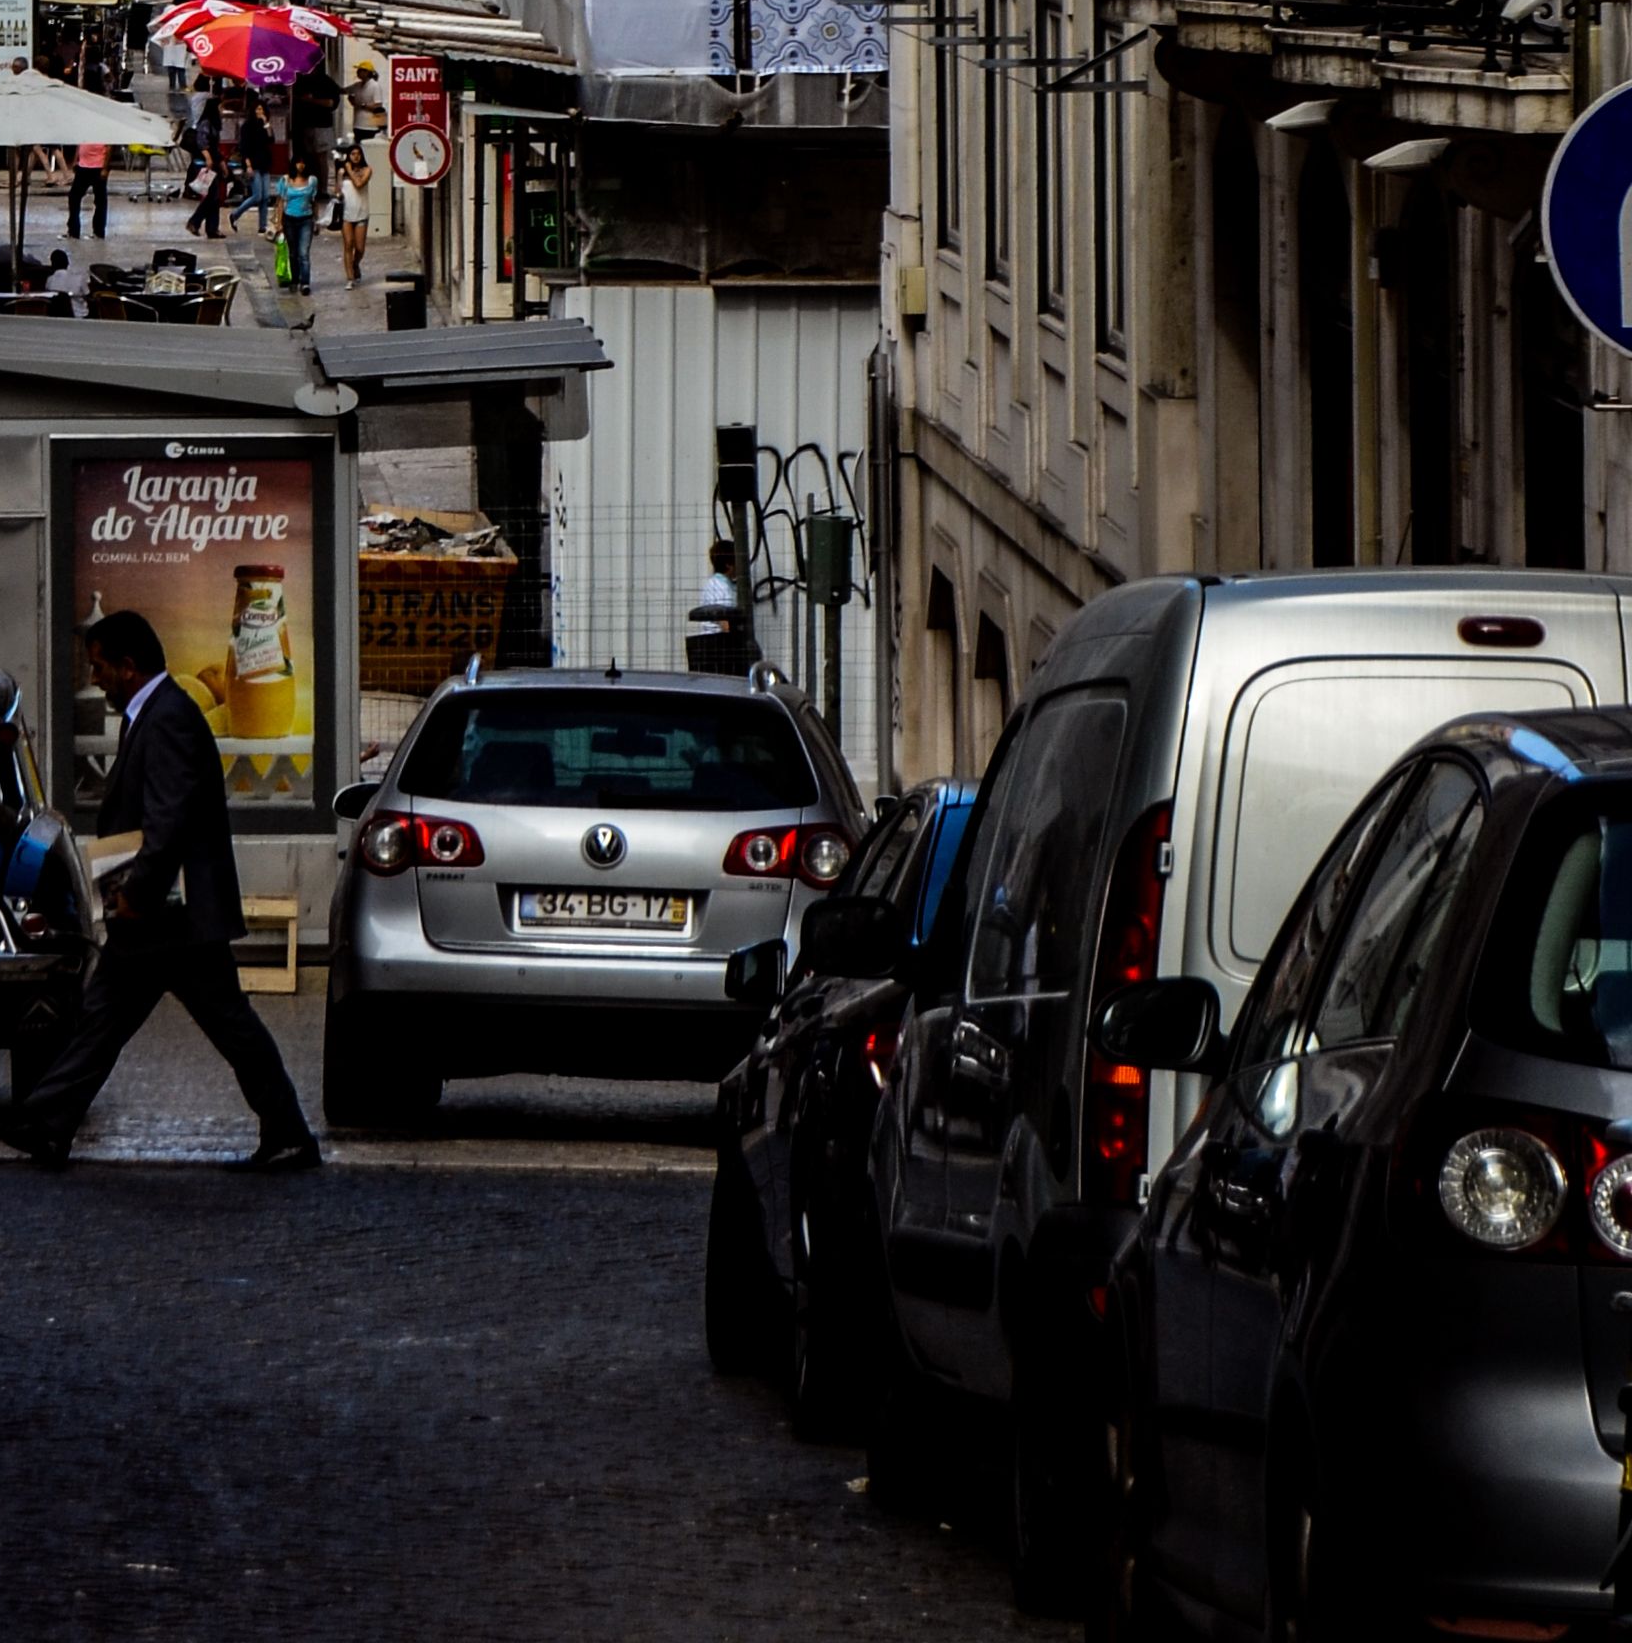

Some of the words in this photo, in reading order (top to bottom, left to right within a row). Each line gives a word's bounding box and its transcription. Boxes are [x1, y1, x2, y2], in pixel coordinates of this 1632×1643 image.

[123, 466, 257, 513] Laranja
[91, 506, 136, 542] do
[144, 504, 289, 552] Algarve
[91, 553, 140, 564] COMPAL
[143, 552, 162, 563] FAZ
[165, 552, 190, 563] BEM
